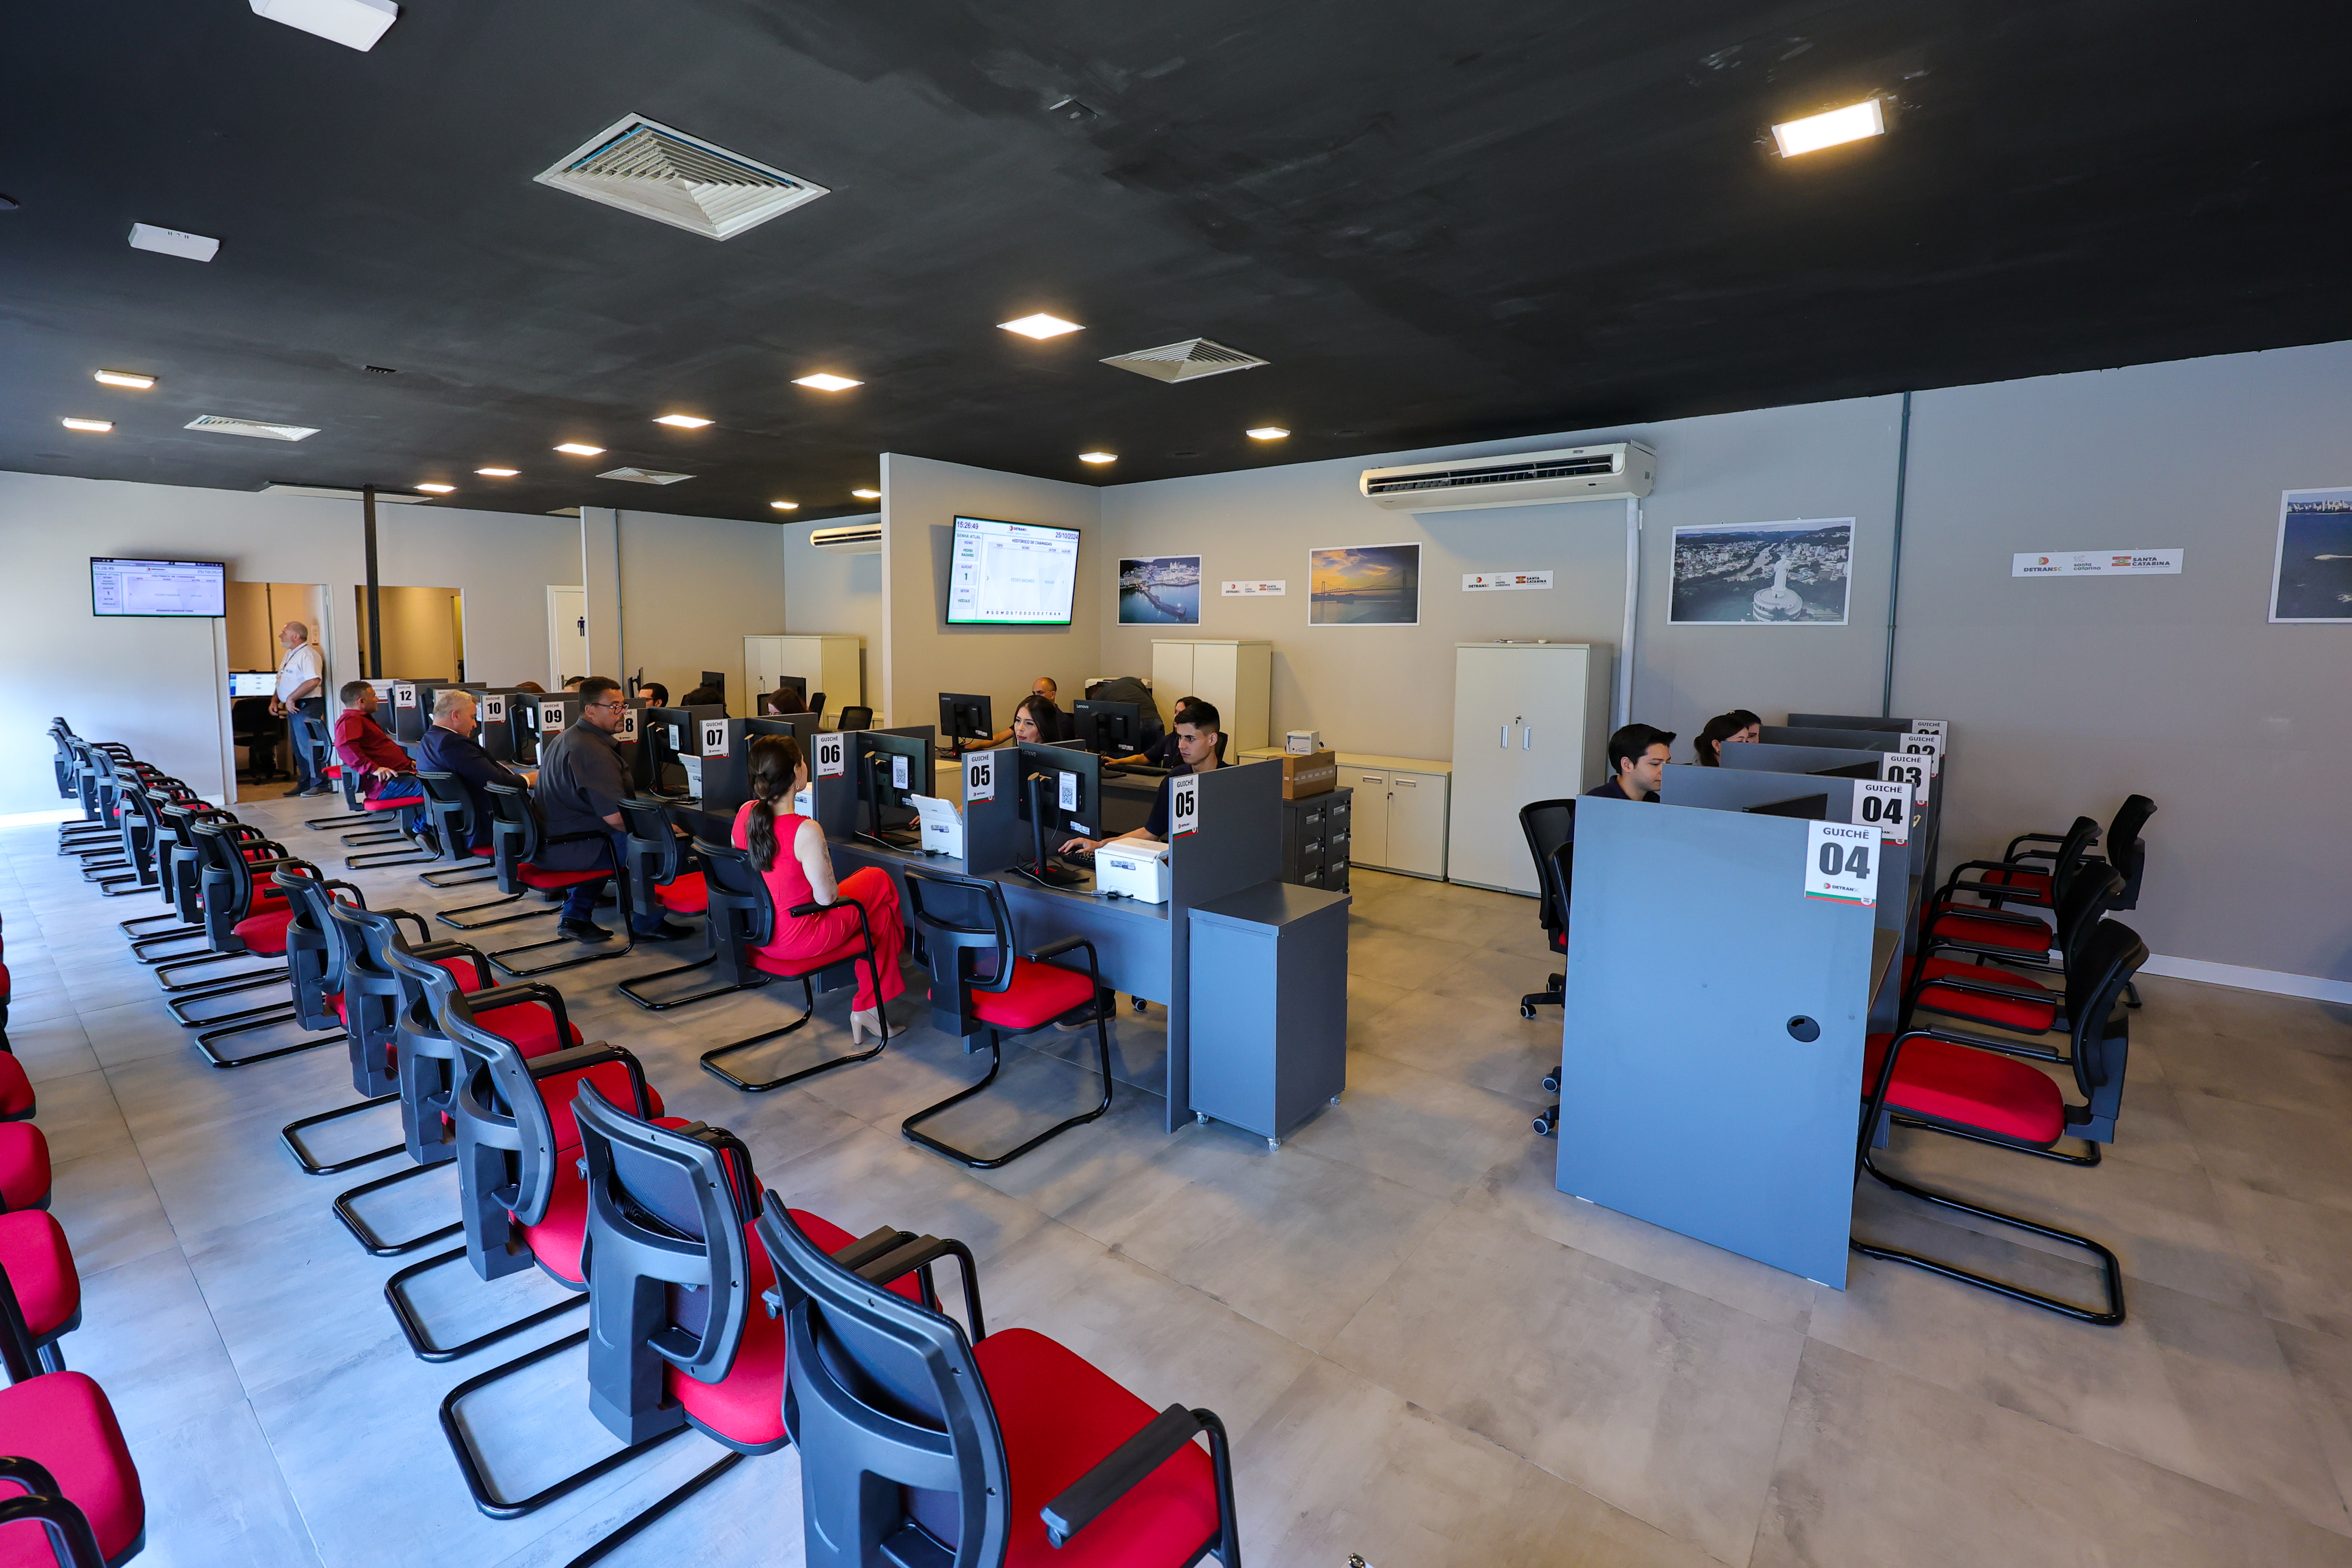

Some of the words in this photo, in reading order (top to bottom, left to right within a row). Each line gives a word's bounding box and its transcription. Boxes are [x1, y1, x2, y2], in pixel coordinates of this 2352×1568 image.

[957, 521, 979, 530] 15:26:49
[399, 691, 412, 701] 12
[487, 702, 501, 714] 10
[545, 710, 562, 723] 09
[625, 718, 634, 732] 8
[707, 729, 723, 746] 07
[821, 745, 840, 764] 06
[971, 765, 990, 787] 05
[1177, 778, 1194, 787] GUICHÊ
[1888, 766, 1922, 788] 03
[1866, 784, 1902, 793] GUICHÊ
[1176, 790, 1194, 818] 05
[1862, 796, 1903, 825] 04
[1823, 827, 1869, 839] GUICHÊ
[1819, 842, 1870, 879] 04
